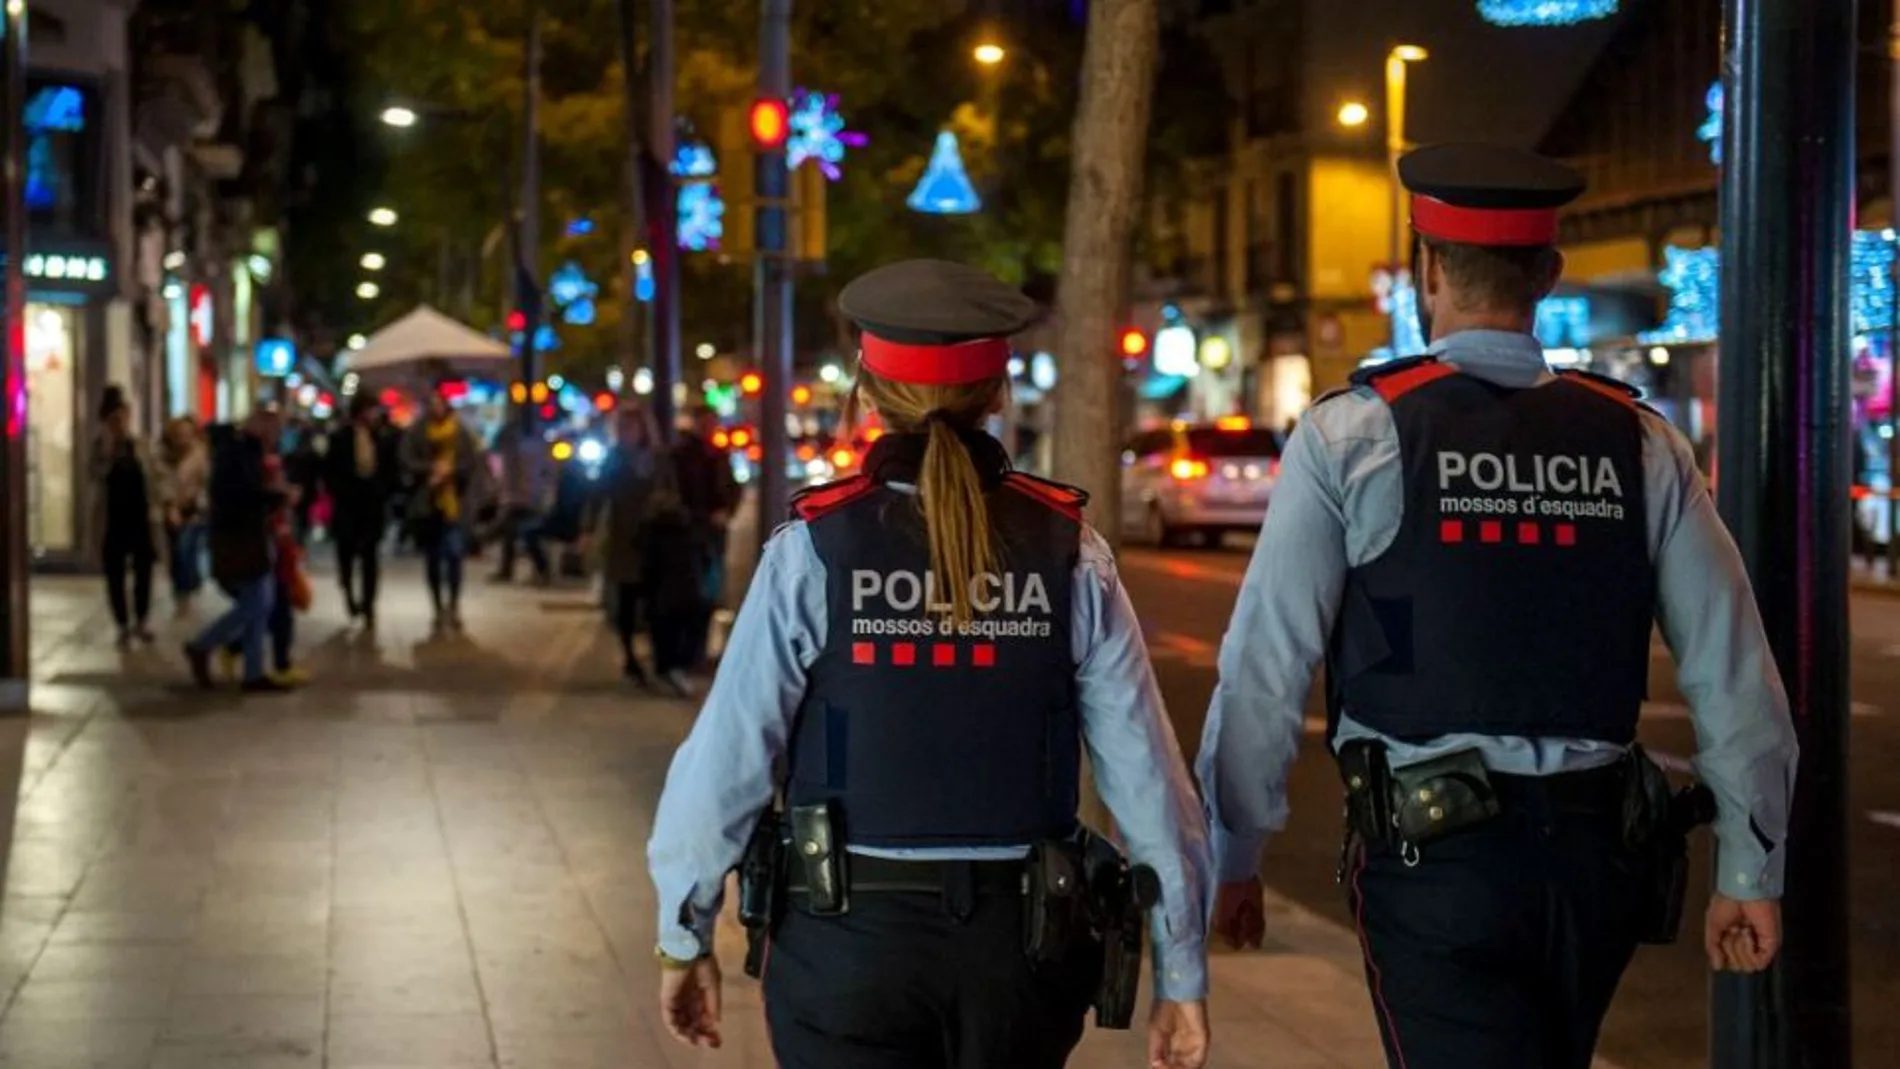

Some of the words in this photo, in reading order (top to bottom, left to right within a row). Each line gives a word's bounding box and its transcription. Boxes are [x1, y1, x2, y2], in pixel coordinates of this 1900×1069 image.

[1437, 451, 1623, 497] POLICIA
[1440, 496, 1518, 514] mossos
[852, 568, 1052, 613] POLCIA
[852, 617, 934, 635] mossos
[938, 616, 1051, 639] desquadra
